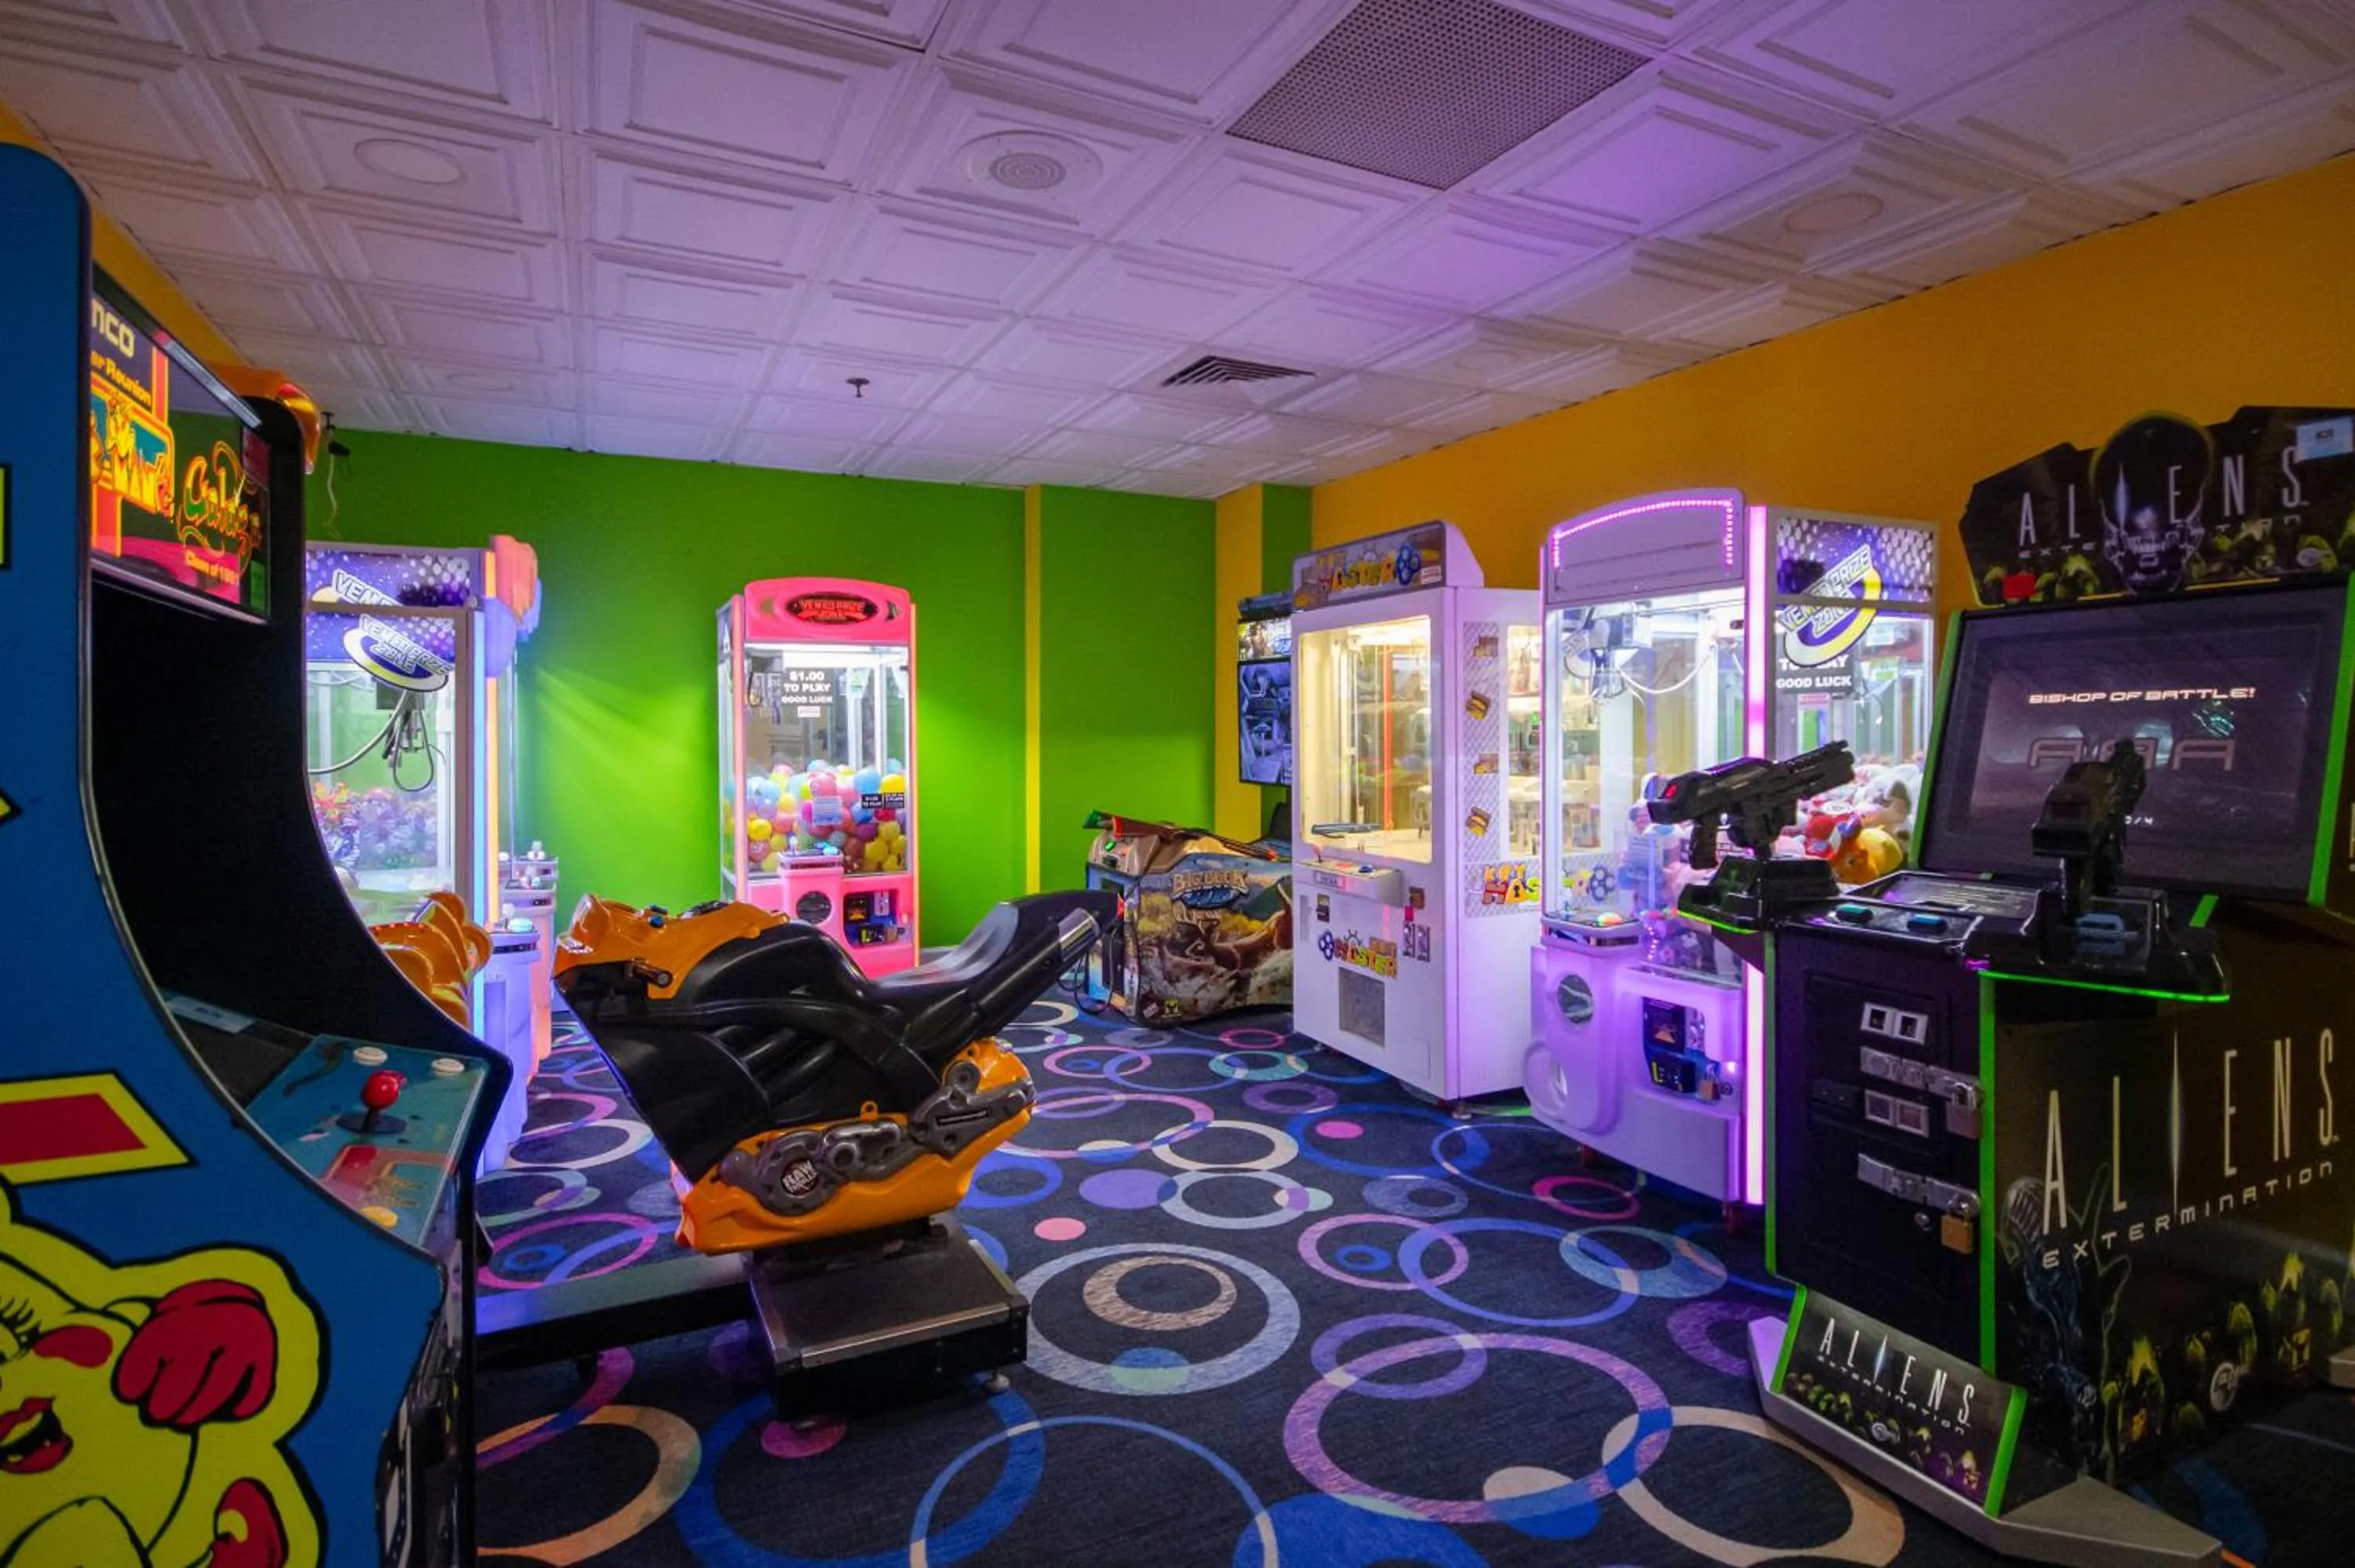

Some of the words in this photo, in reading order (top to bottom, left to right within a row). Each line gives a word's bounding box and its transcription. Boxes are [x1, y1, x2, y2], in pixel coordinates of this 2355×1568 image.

[92, 299, 134, 358] nco
[2019, 445, 2302, 547] ALIENS
[370, 643, 416, 673] ZONE
[789, 671, 825, 681] $1.00
[783, 683, 799, 692] TO
[801, 683, 831, 692] PLAY
[1776, 678, 1813, 688] GOOD
[1815, 675, 1853, 687] LUCK
[2028, 692, 2106, 704] BISHOP
[2109, 691, 2143, 702] OF
[2145, 687, 2257, 701] BATTLE!
[2043, 1026, 2335, 1235] ALIENS
[2042, 1160, 2333, 1269] EXTERMINATION
[1819, 1318, 1975, 1424] ALIENS
